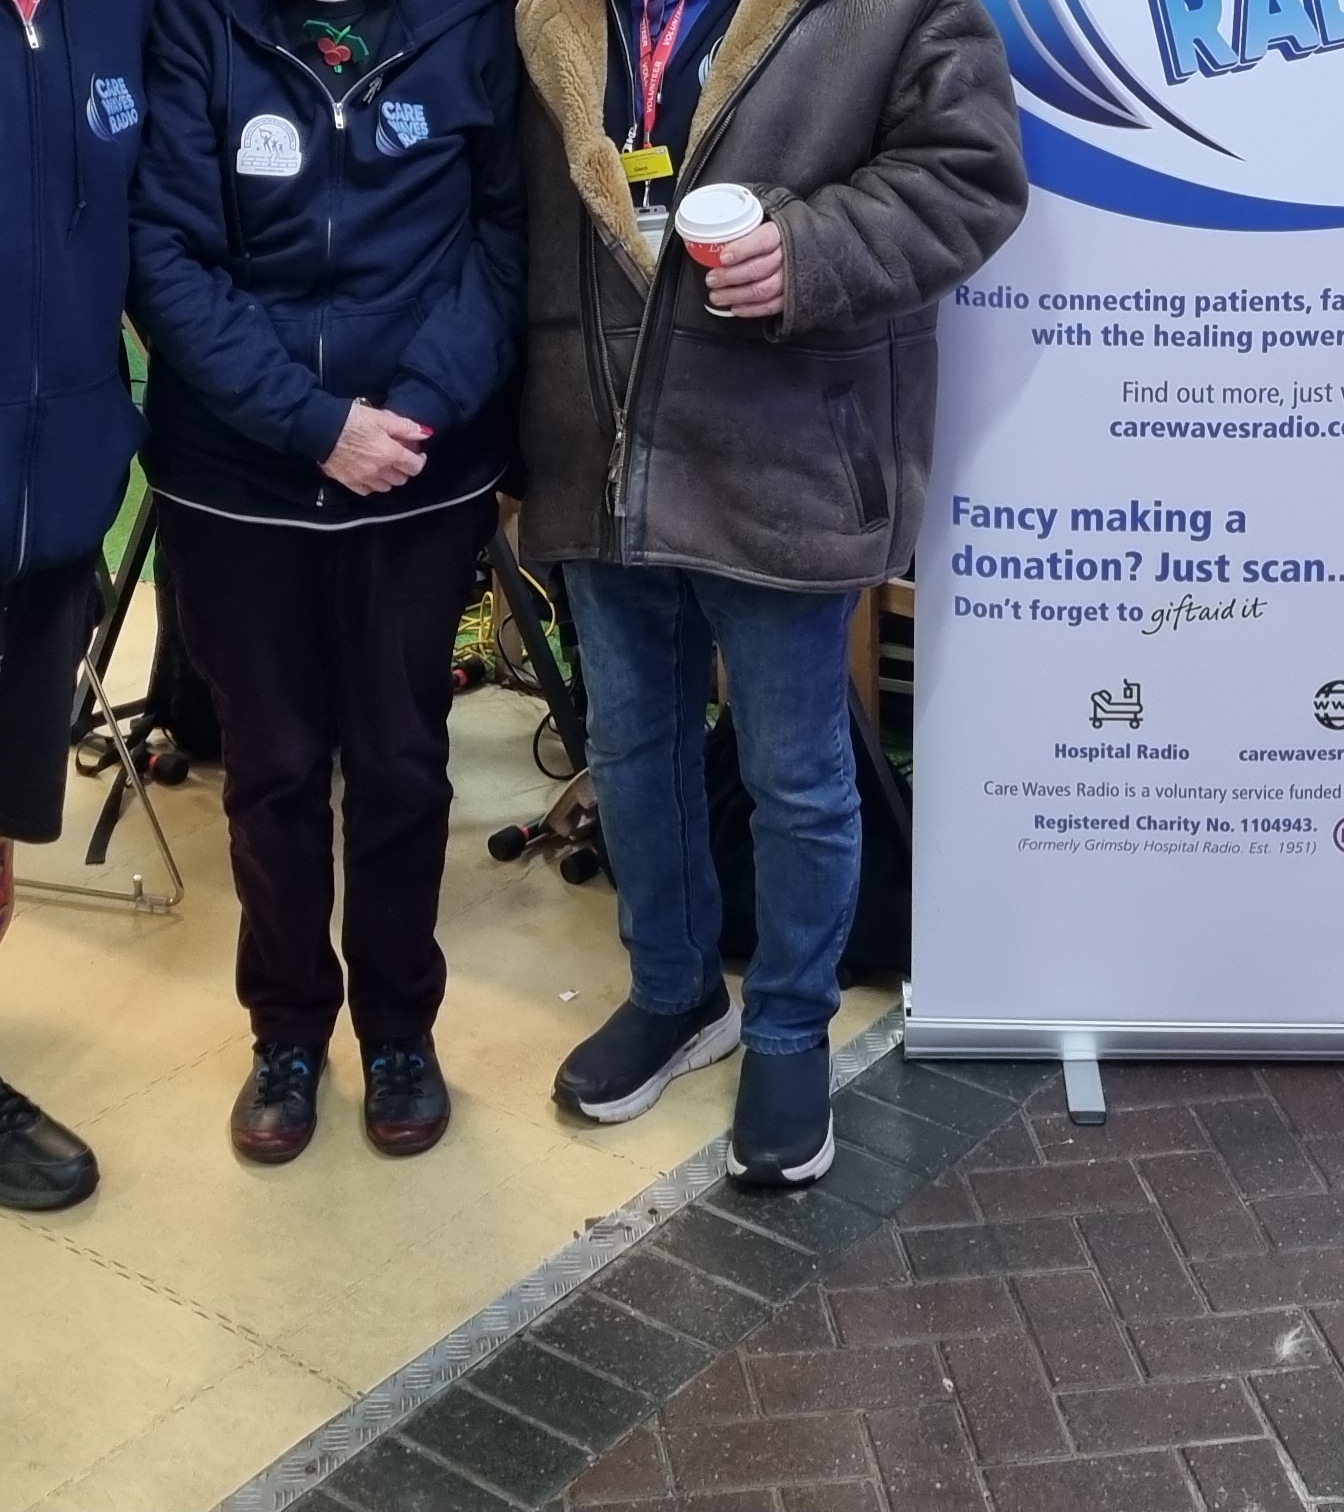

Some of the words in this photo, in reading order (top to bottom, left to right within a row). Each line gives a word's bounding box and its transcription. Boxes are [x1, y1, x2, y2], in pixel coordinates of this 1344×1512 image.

[96, 78, 128, 98] CARE
[646, 61, 662, 113] VOLUNTEER
[101, 93, 135, 116] WAVES
[382, 101, 425, 121] CARE
[109, 108, 138, 134] RADIO
[387, 120, 429, 137] WAVES
[955, 285, 1030, 310] Radio
[1038, 289, 1186, 318] connecting
[1195, 288, 1312, 318] patients,
[1031, 323, 1092, 346] with
[1101, 323, 1145, 347] the
[1154, 324, 1253, 353] healing
[1122, 380, 1168, 404] Find
[1176, 384, 1215, 404] out
[1222, 386, 1285, 407] more,
[1291, 381, 1333, 410] just
[952, 495, 1057, 540] Fancy
[1070, 500, 1212, 542] making
[1224, 509, 1247, 534] a
[951, 544, 1143, 582] donation?
[1155, 551, 1231, 583] Just
[954, 595, 1022, 621] Don't
[1029, 599, 1110, 626] forget
[1117, 603, 1144, 622] to
[1241, 597, 1268, 620] it
[1054, 743, 1131, 762] Hospital
[1137, 743, 1190, 760] Radio
[983, 780, 1019, 796] Care
[1021, 781, 1071, 797] Waves
[1076, 782, 1120, 797] Radio
[1125, 782, 1136, 798] is
[1141, 786, 1150, 798] a
[1155, 783, 1227, 804] voluntary
[1231, 785, 1284, 800] service
[1289, 784, 1341, 800] funded
[1034, 814, 1130, 833] Registered
[1136, 815, 1201, 836] Charity
[1206, 817, 1235, 833] No.
[1240, 817, 1318, 833] 1104943.
[1017, 838, 1081, 854] (Formerly
[1084, 839, 1140, 855] Grimsby
[1143, 839, 1199, 855] Hospital
[1202, 840, 1244, 855] Radio.
[1249, 841, 1272, 855] Est.
[1278, 841, 1317, 855] 1951)
